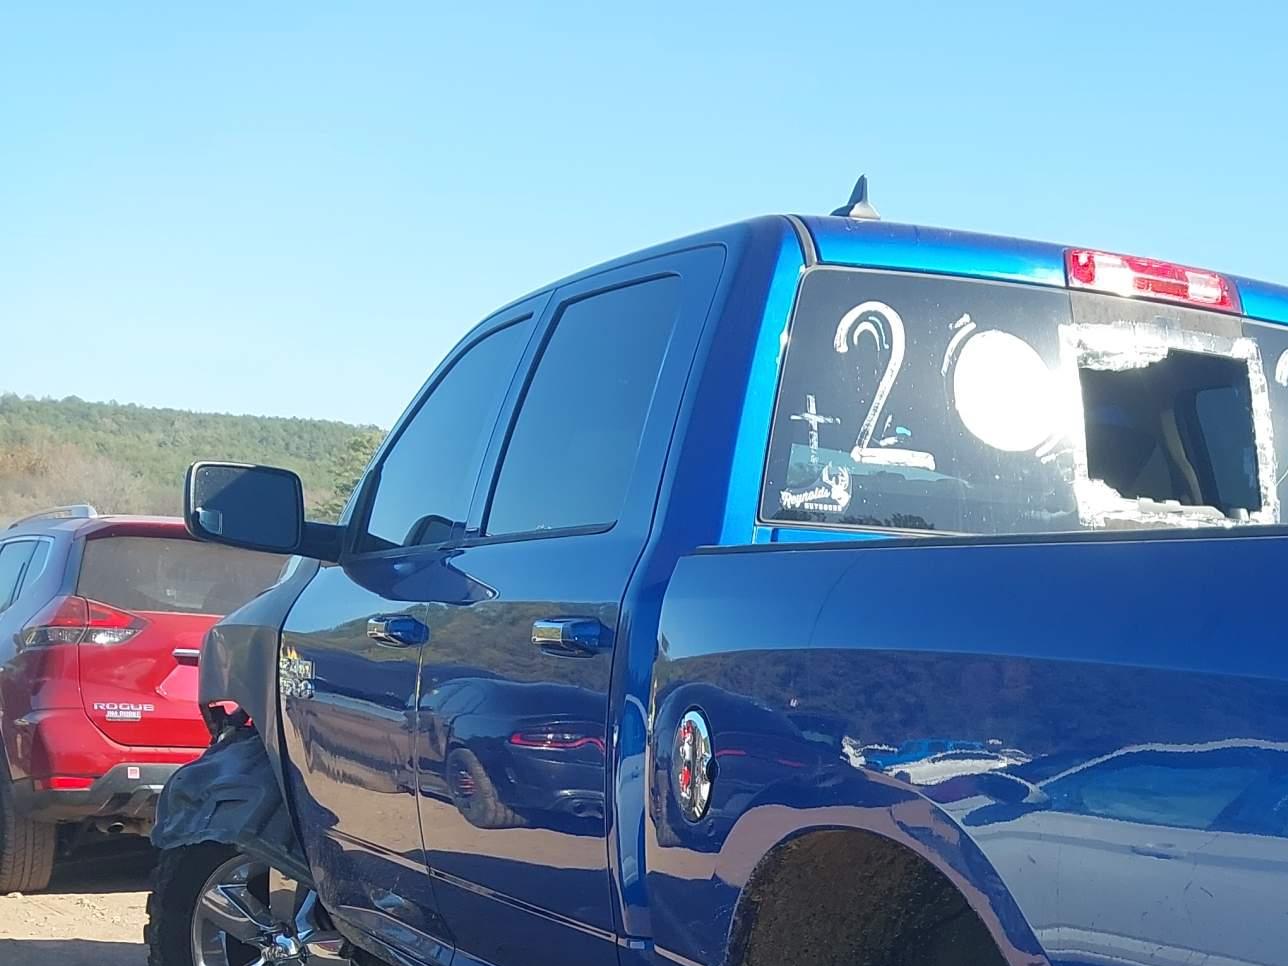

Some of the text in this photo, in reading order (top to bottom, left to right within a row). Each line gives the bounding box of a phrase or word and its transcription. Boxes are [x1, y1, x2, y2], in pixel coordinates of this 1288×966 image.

[780, 486, 831, 509] Reynolds
[804, 502, 843, 512] OUTDOORS
[93, 702, 155, 712] ROGUE
